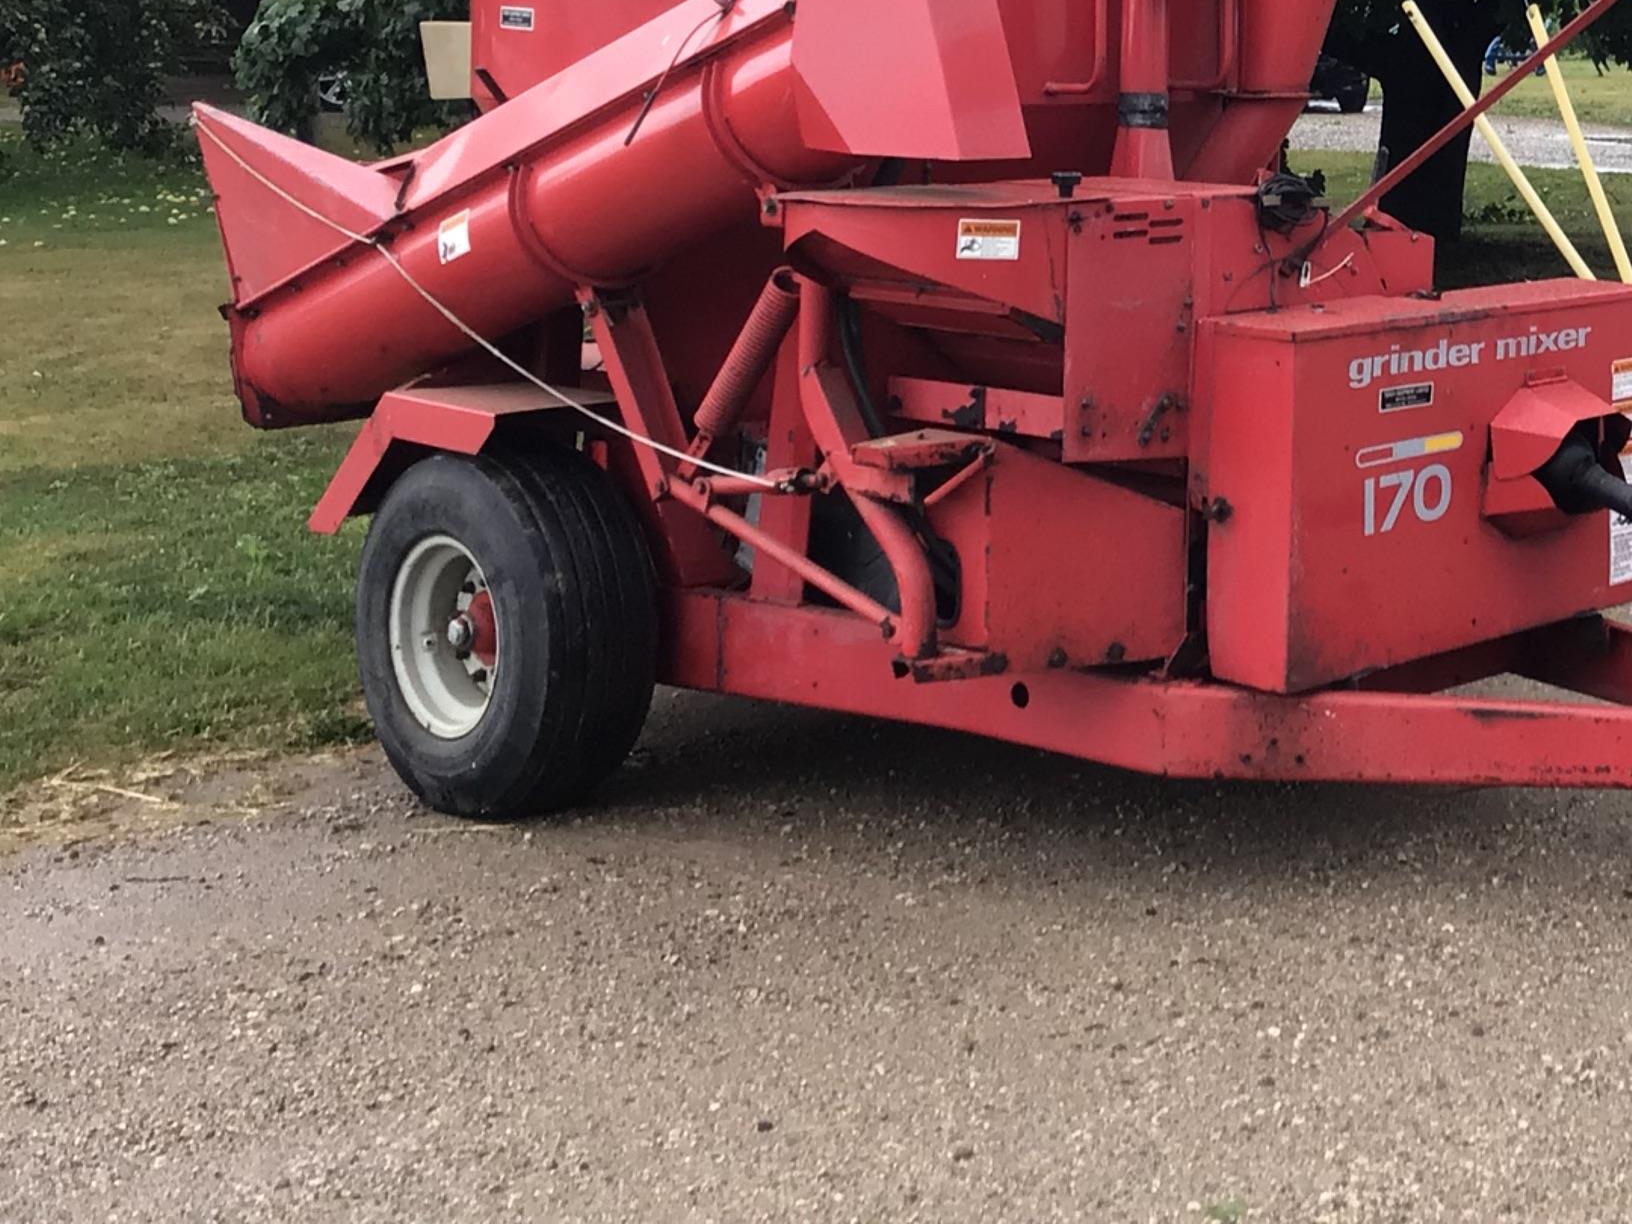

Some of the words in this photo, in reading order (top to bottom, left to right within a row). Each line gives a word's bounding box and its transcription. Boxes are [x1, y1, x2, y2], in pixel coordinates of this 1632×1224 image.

[1349, 339, 1485, 389] grinder
[1496, 326, 1592, 361] mixer
[1364, 463, 1452, 536] 170
